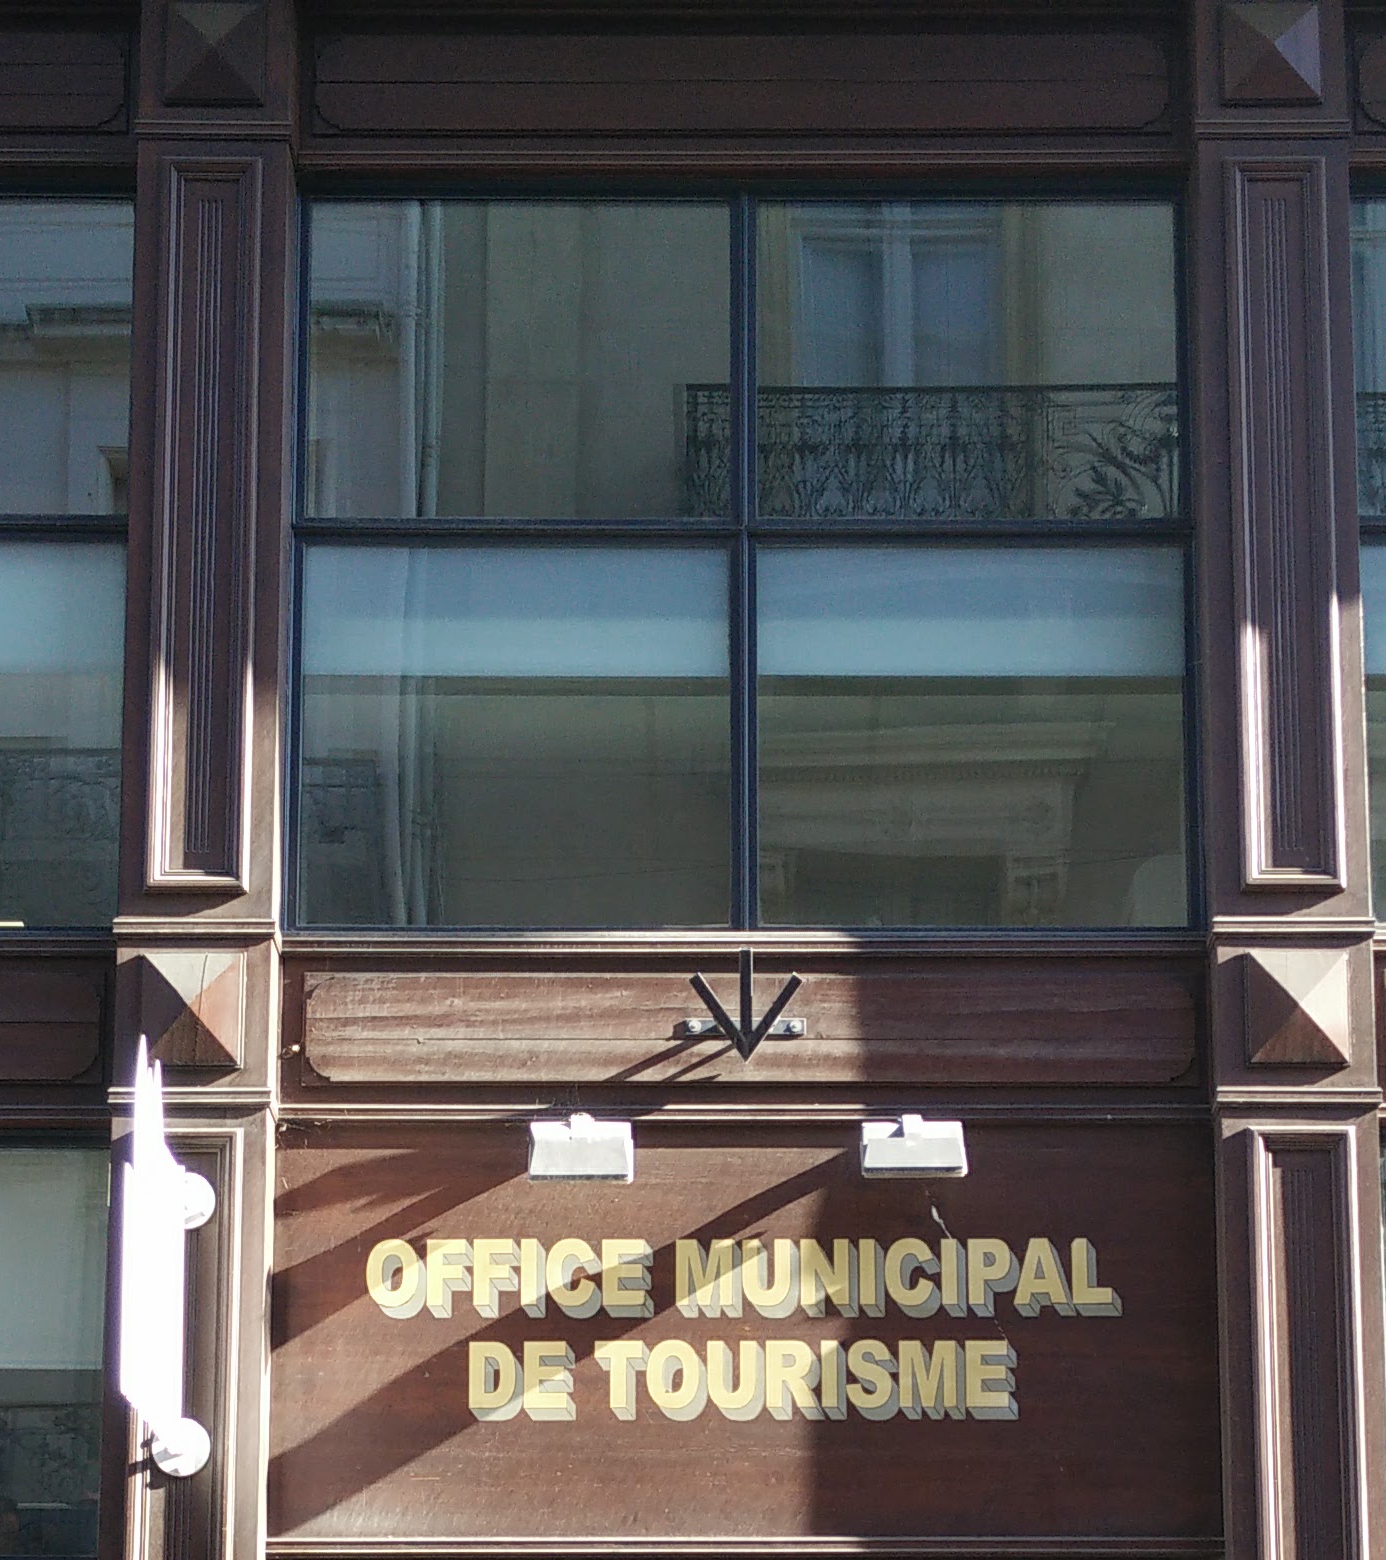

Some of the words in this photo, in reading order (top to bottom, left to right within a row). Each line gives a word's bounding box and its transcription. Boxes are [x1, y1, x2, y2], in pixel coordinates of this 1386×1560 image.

[366, 1237, 654, 1319] OFFICE
[675, 1237, 1123, 1319] MUNICIPAL
[468, 1339, 576, 1421] DE
[596, 1339, 1019, 1422] TOURISME
